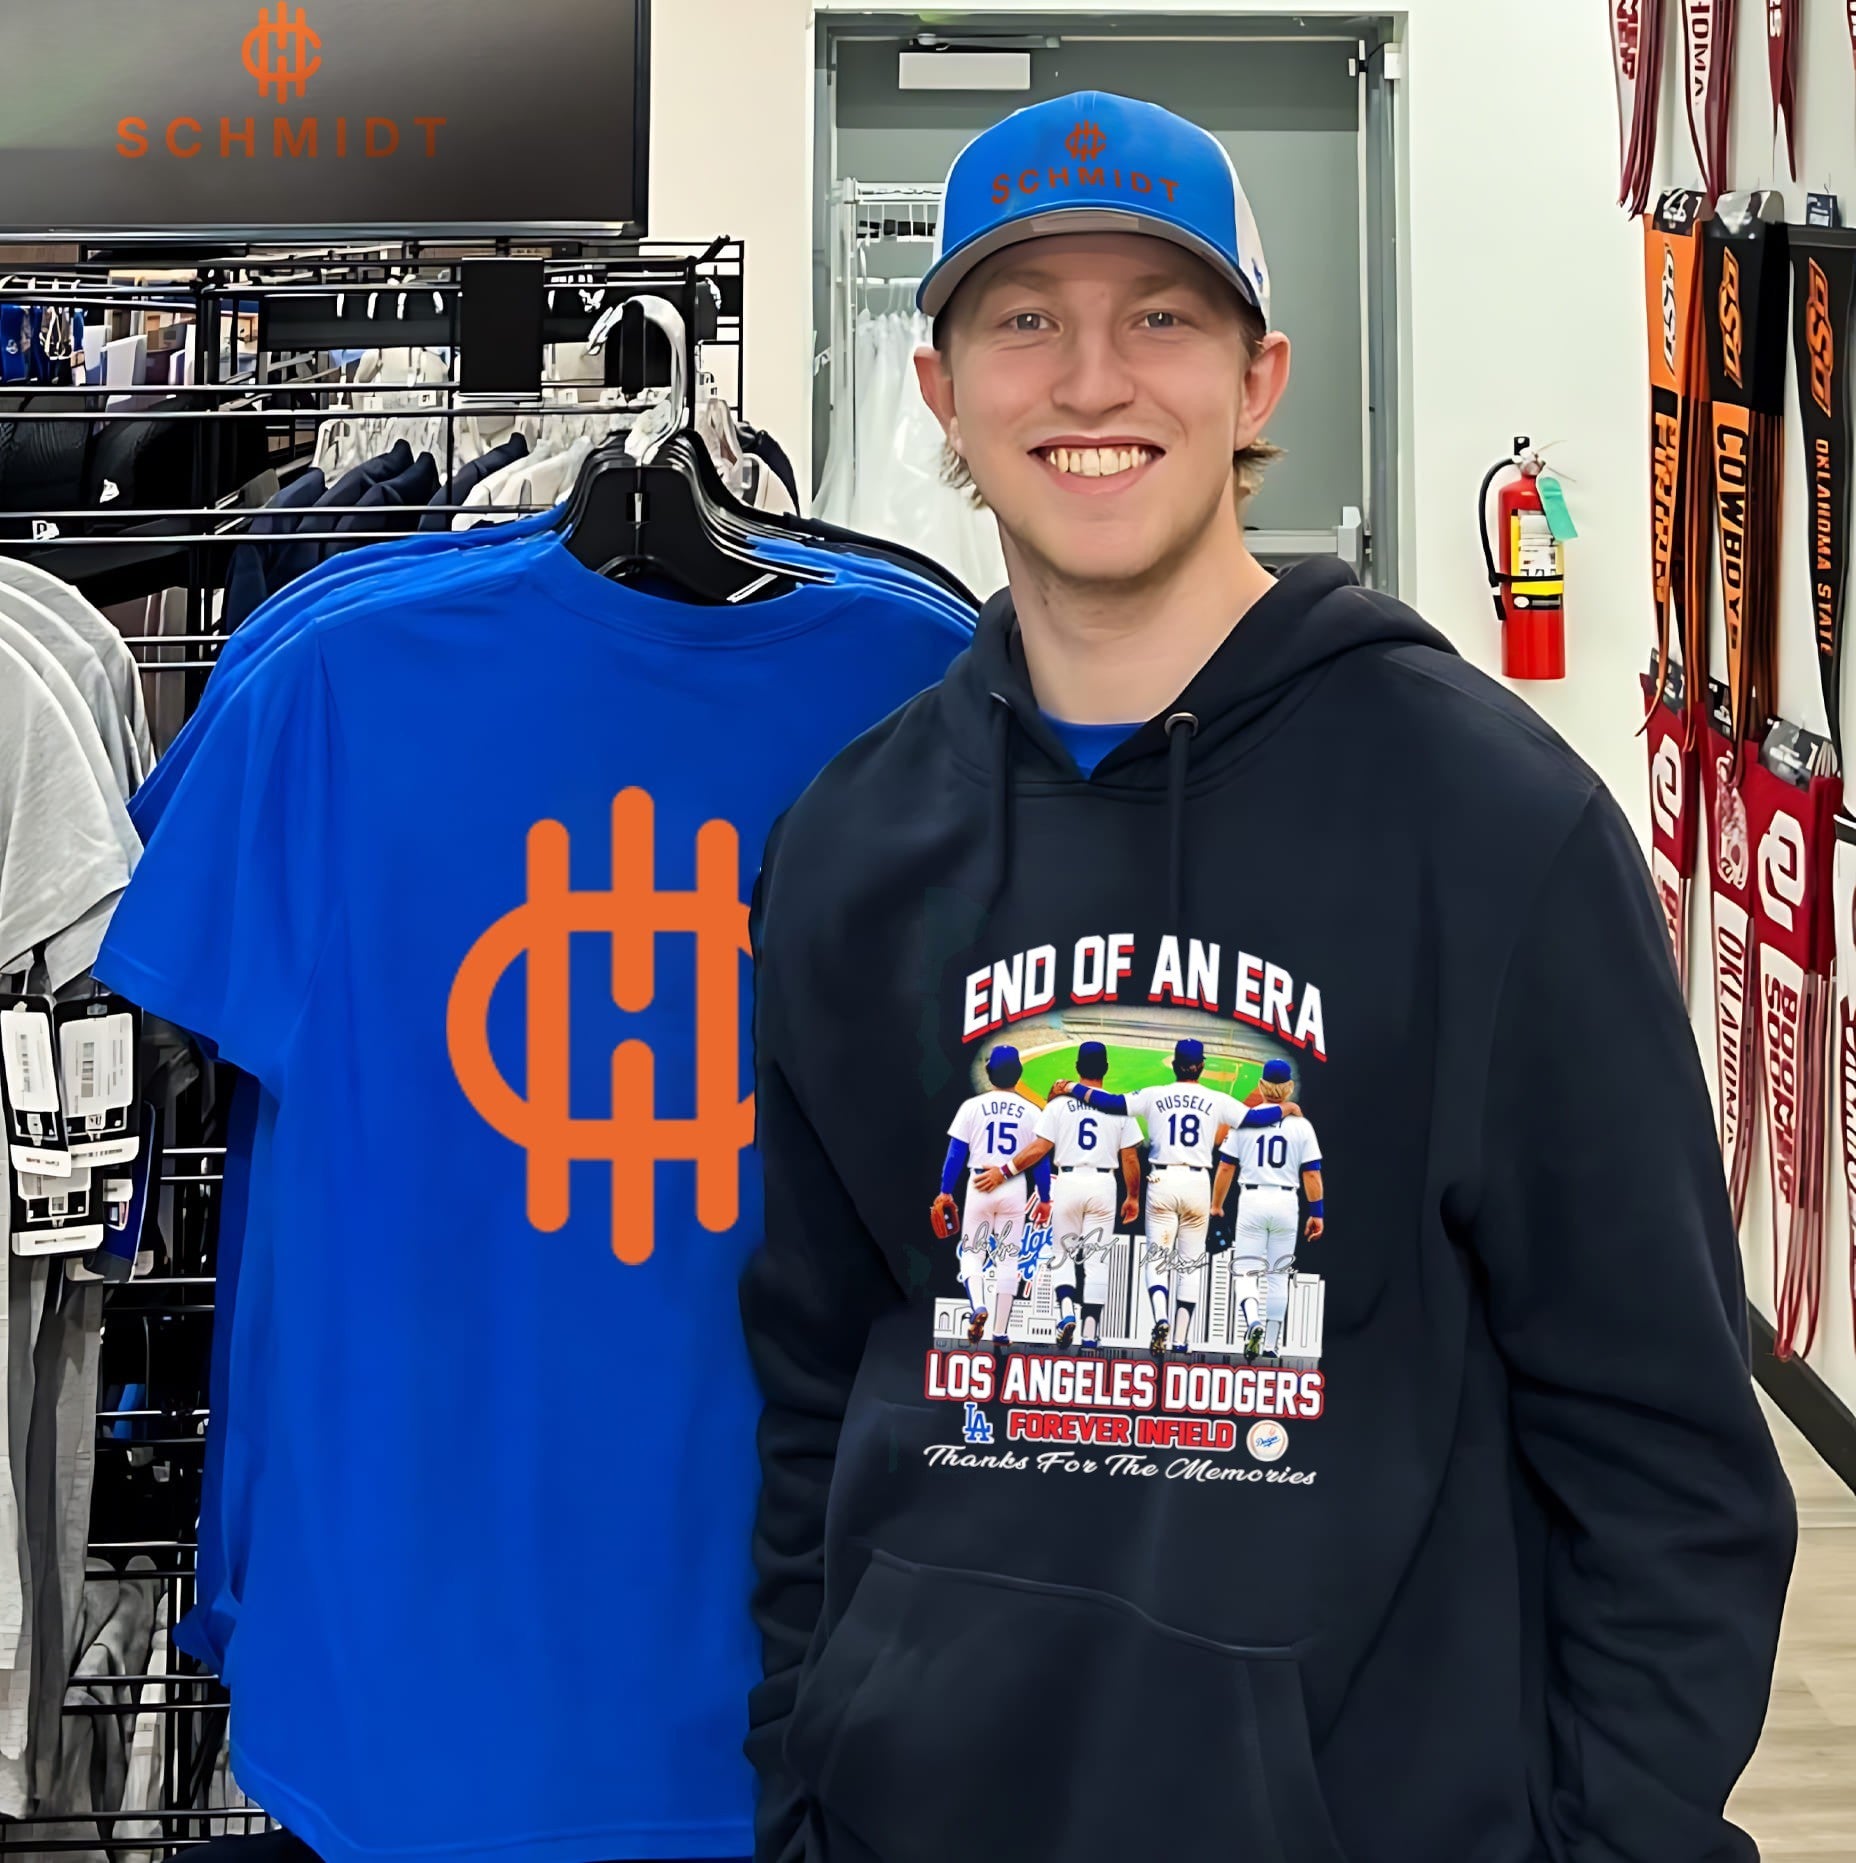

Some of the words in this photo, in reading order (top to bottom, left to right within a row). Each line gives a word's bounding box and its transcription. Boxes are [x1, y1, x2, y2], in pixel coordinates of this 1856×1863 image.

[116, 117, 449, 159] SCHMIDT
[991, 166, 1180, 204] SCHMIDT
[1815, 438, 1832, 570] OKLAHOMA
[962, 944, 1056, 1043] END
[1070, 933, 1135, 1006] OF
[1147, 934, 1220, 1011] AN
[1233, 950, 1327, 1062] ERA
[981, 1100, 1026, 1119] LOPES
[1155, 1095, 1213, 1117] RUSSELL
[985, 1121, 1018, 1155] 15
[1078, 1117, 1098, 1150] 6
[1168, 1114, 1200, 1147] 18
[1255, 1134, 1288, 1169] 10
[926, 1351, 995, 1402] LOS
[1002, 1354, 1157, 1411] ANGELES
[1163, 1362, 1325, 1419] DODGERS
[963, 1401, 995, 1444] LA
[1007, 1410, 1130, 1445] FOREVER
[1136, 1416, 1237, 1450] INFIELD
[923, 1444, 1029, 1472] Thanks
[1036, 1451, 1098, 1476] For
[1104, 1453, 1159, 1478] The
[1165, 1458, 1317, 1486] Memories
